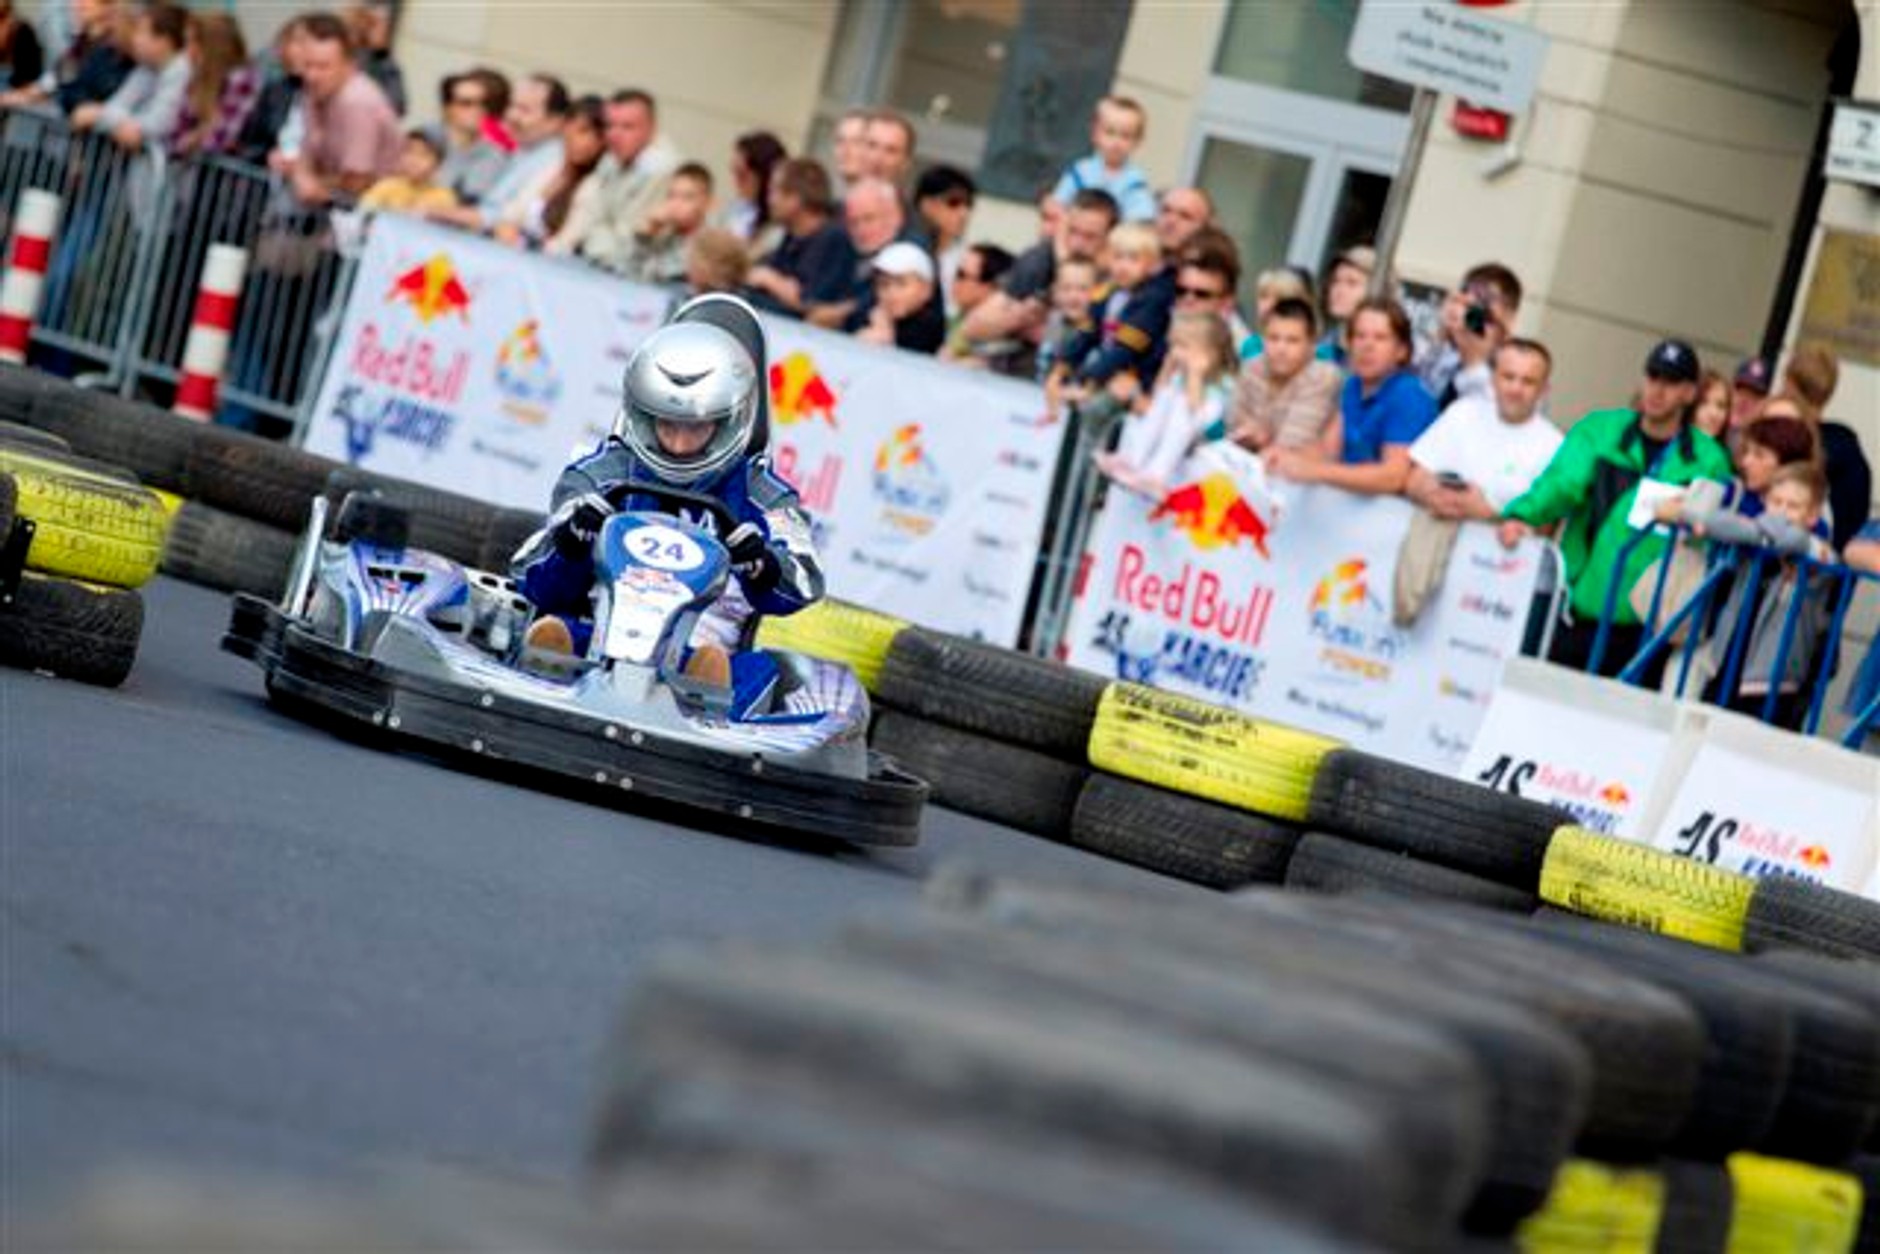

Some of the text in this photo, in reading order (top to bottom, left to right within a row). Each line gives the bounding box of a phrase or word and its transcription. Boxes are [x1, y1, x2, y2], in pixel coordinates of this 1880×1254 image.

[640, 537, 684, 562] 24
[1114, 543, 1190, 620] Red
[1191, 569, 1273, 648] Bull
